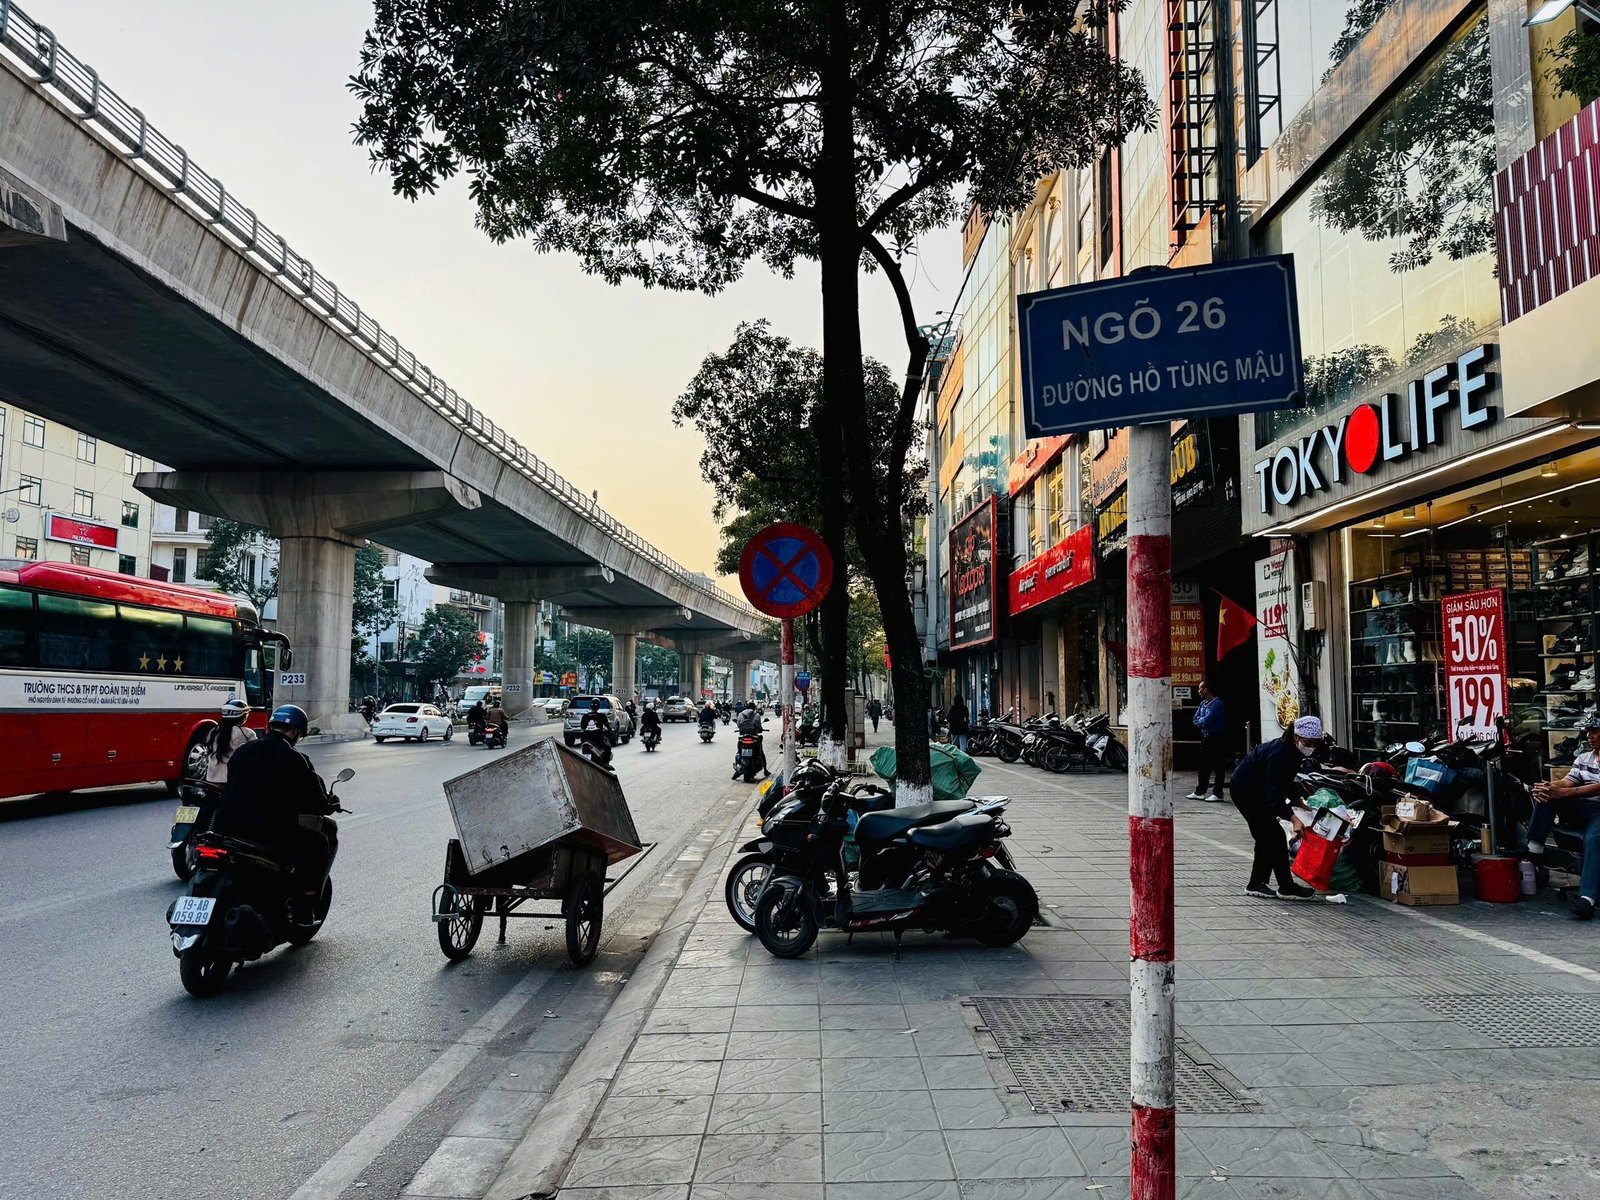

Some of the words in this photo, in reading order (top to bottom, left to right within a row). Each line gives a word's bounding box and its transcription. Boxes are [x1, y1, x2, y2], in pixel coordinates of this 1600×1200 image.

[1062, 298, 1161, 350] NGÕ
[1176, 297, 1226, 334] 26
[1042, 374, 1123, 406] ĐƯỜNG
[1130, 362, 1161, 394] HỒ
[1167, 360, 1229, 389] TÙNG
[1236, 350, 1285, 383] MẬU
[1446, 601, 1463, 614] GIẢM
[1465, 599, 1480, 612] SÂU
[1481, 596, 1498, 609] HƠN
[1450, 614, 1498, 663] 50%
[24, 680, 56, 694] TRƯỜNG
[57, 683, 75, 695] THCS
[76, 684, 81, 694] &
[99, 682, 119, 695] ĐOÀN
[281, 675, 305, 684] P233
